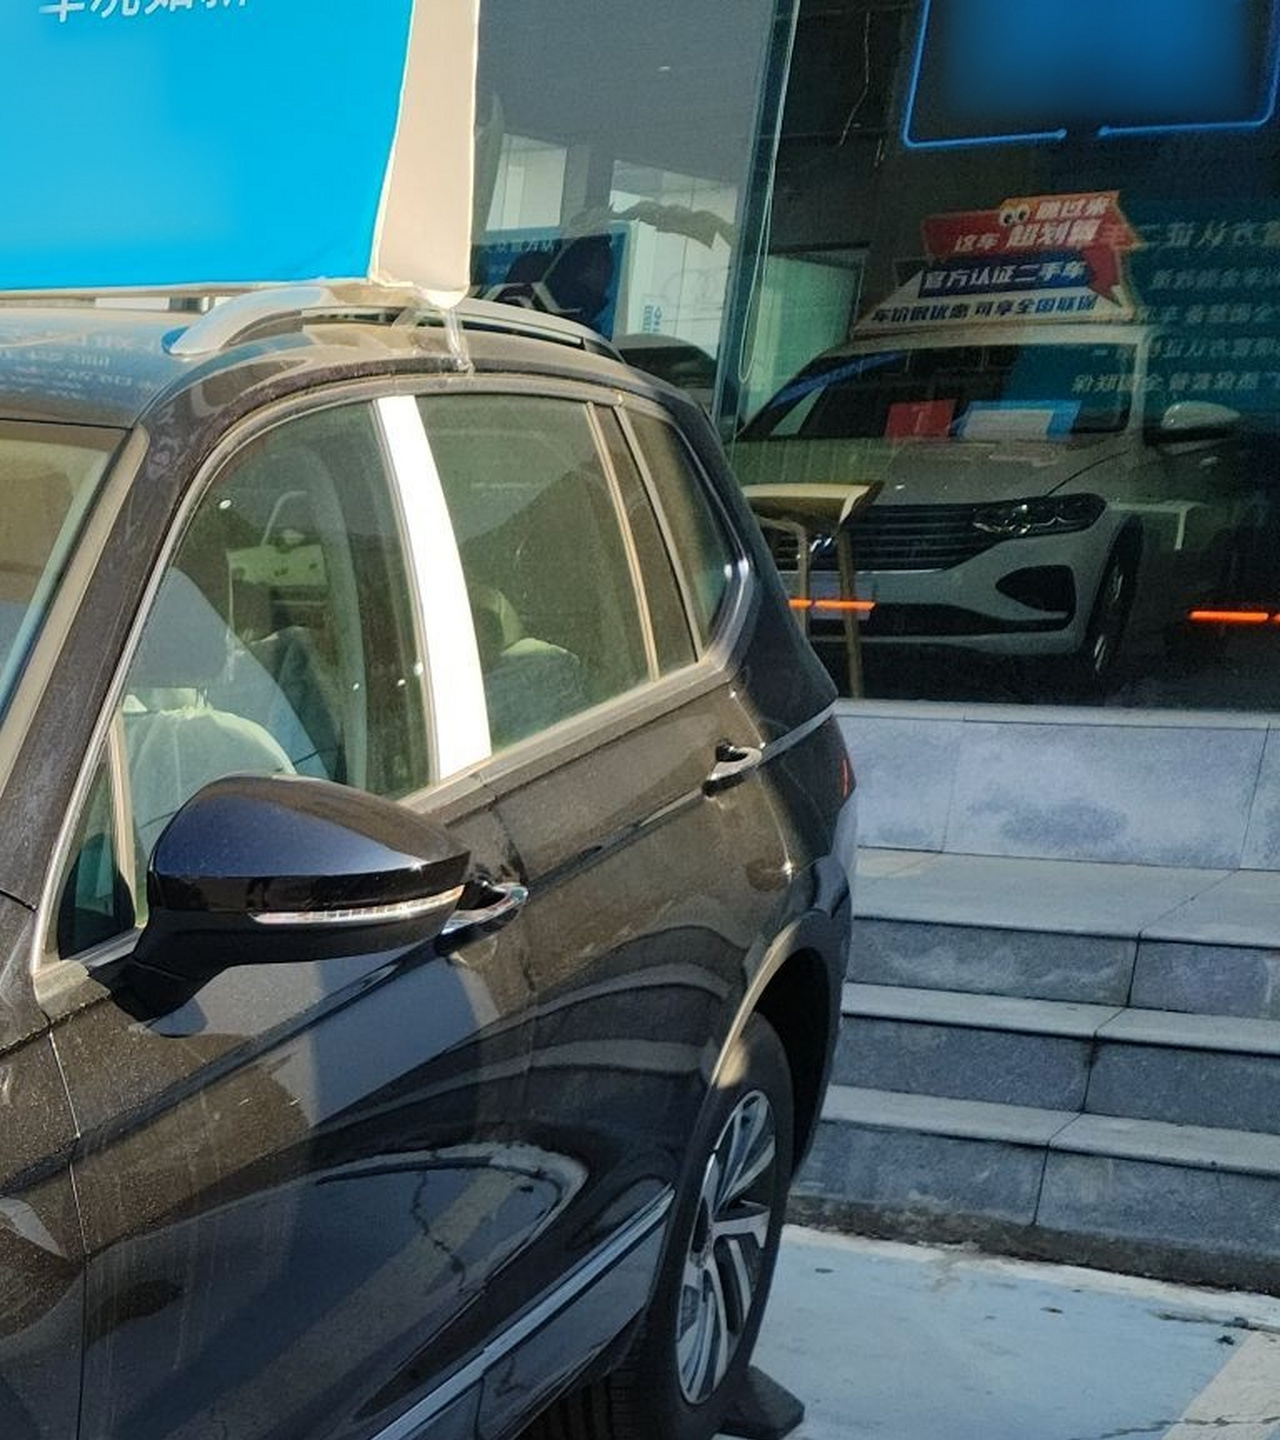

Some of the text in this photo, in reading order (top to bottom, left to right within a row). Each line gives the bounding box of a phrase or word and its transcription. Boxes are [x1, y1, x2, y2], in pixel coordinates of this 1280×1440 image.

[924, 260, 1087, 289] 官方认证二手车
